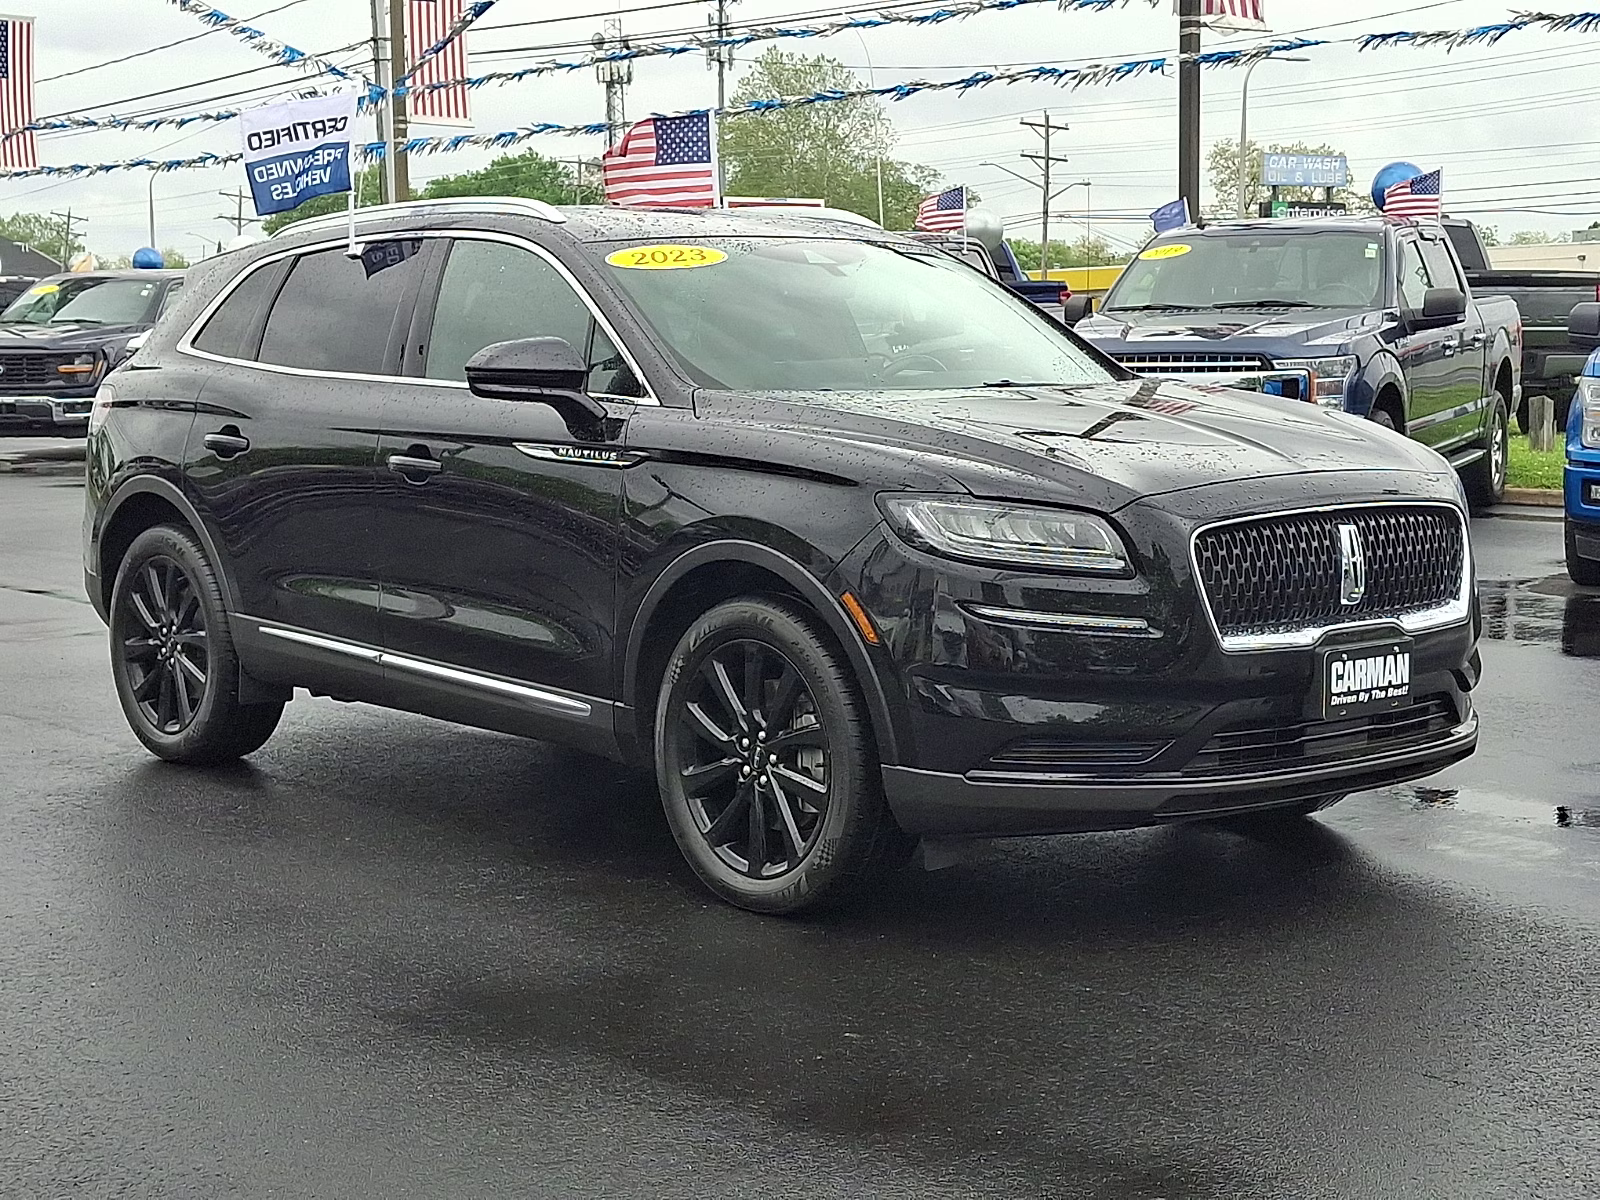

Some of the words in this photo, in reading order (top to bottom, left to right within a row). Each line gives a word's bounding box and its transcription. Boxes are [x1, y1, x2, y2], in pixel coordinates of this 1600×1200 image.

[1269, 156, 1297, 168] CAR
[1303, 157, 1340, 171] WASH
[1268, 172, 1287, 182] OIL
[1295, 172, 1304, 182] &
[1311, 172, 1343, 183] LUBE
[631, 248, 707, 265] 2023
[558, 447, 618, 461] NAUTILUS
[1331, 653, 1410, 694] CARMAN
[1331, 694, 1357, 706] Driven
[1359, 691, 1370, 703] By
[1371, 689, 1386, 700] The
[1387, 685, 1409, 697] Best!
